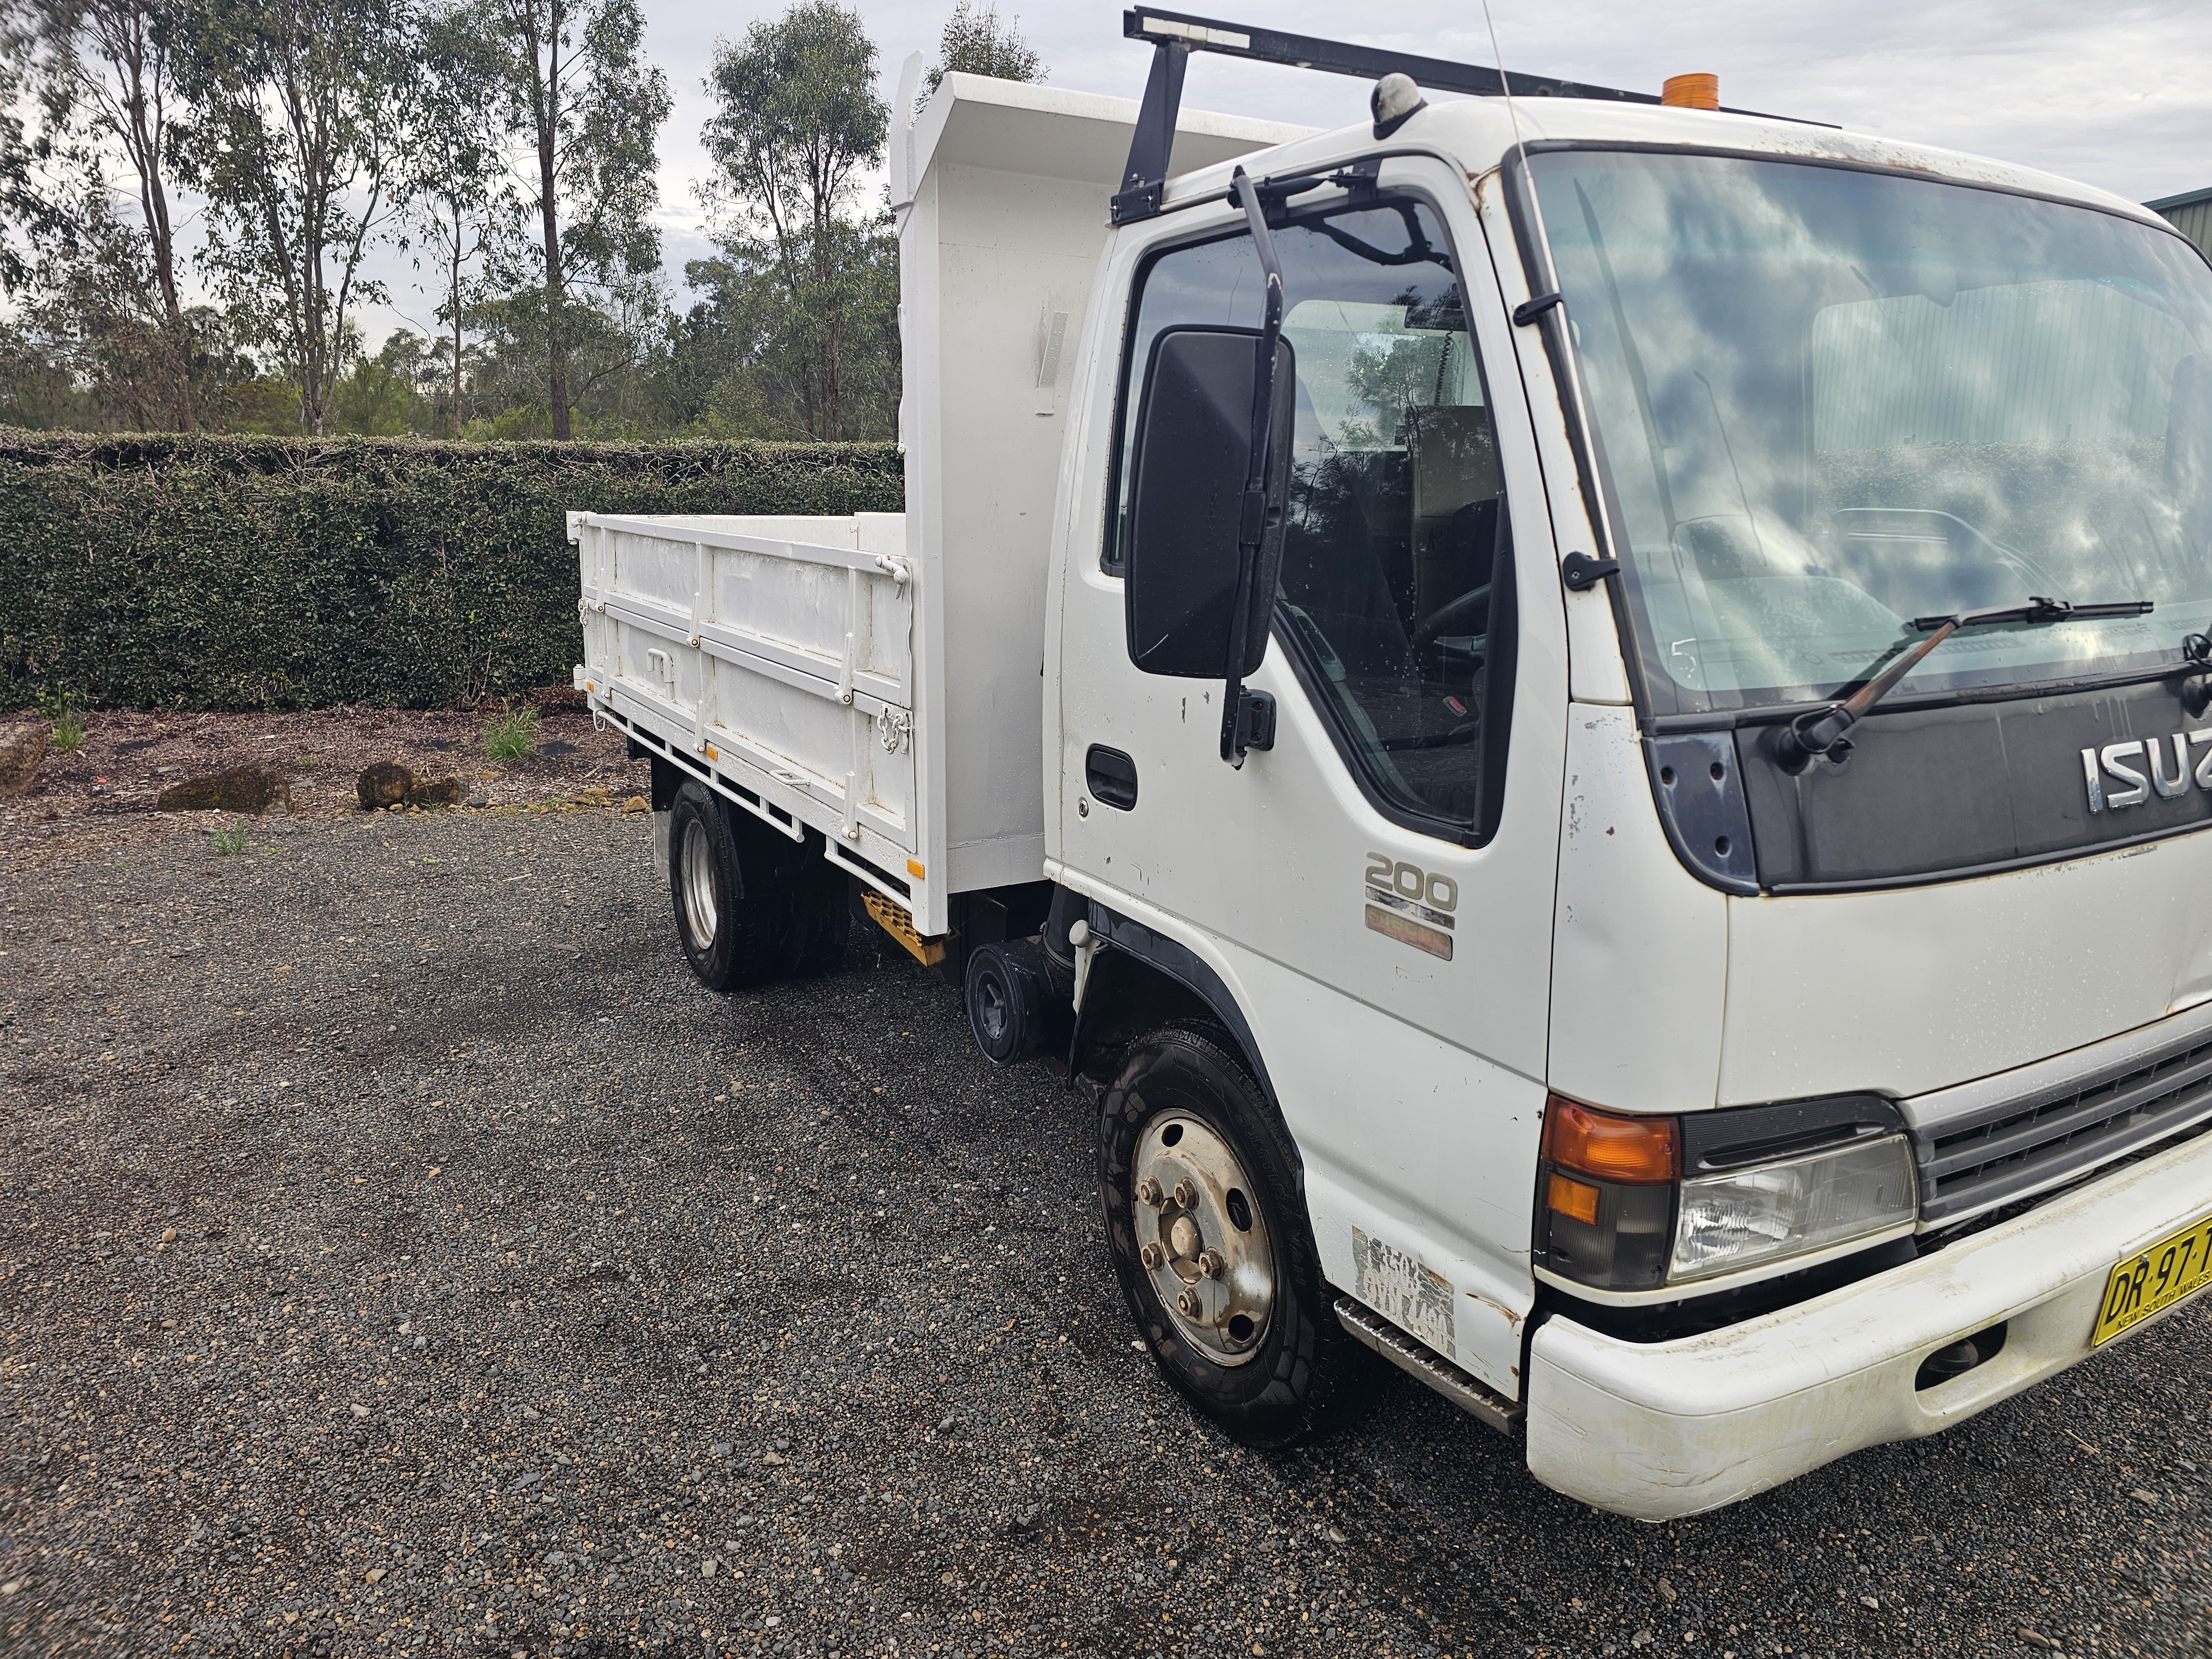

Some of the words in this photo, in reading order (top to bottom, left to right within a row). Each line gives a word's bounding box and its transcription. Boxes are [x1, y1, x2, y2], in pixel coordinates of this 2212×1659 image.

[1365, 851, 1458, 912] 200
[2116, 1308, 2140, 1331] NEW
[2142, 1288, 2176, 1316] SOUTH
[2179, 1269, 2210, 1295] WALES
